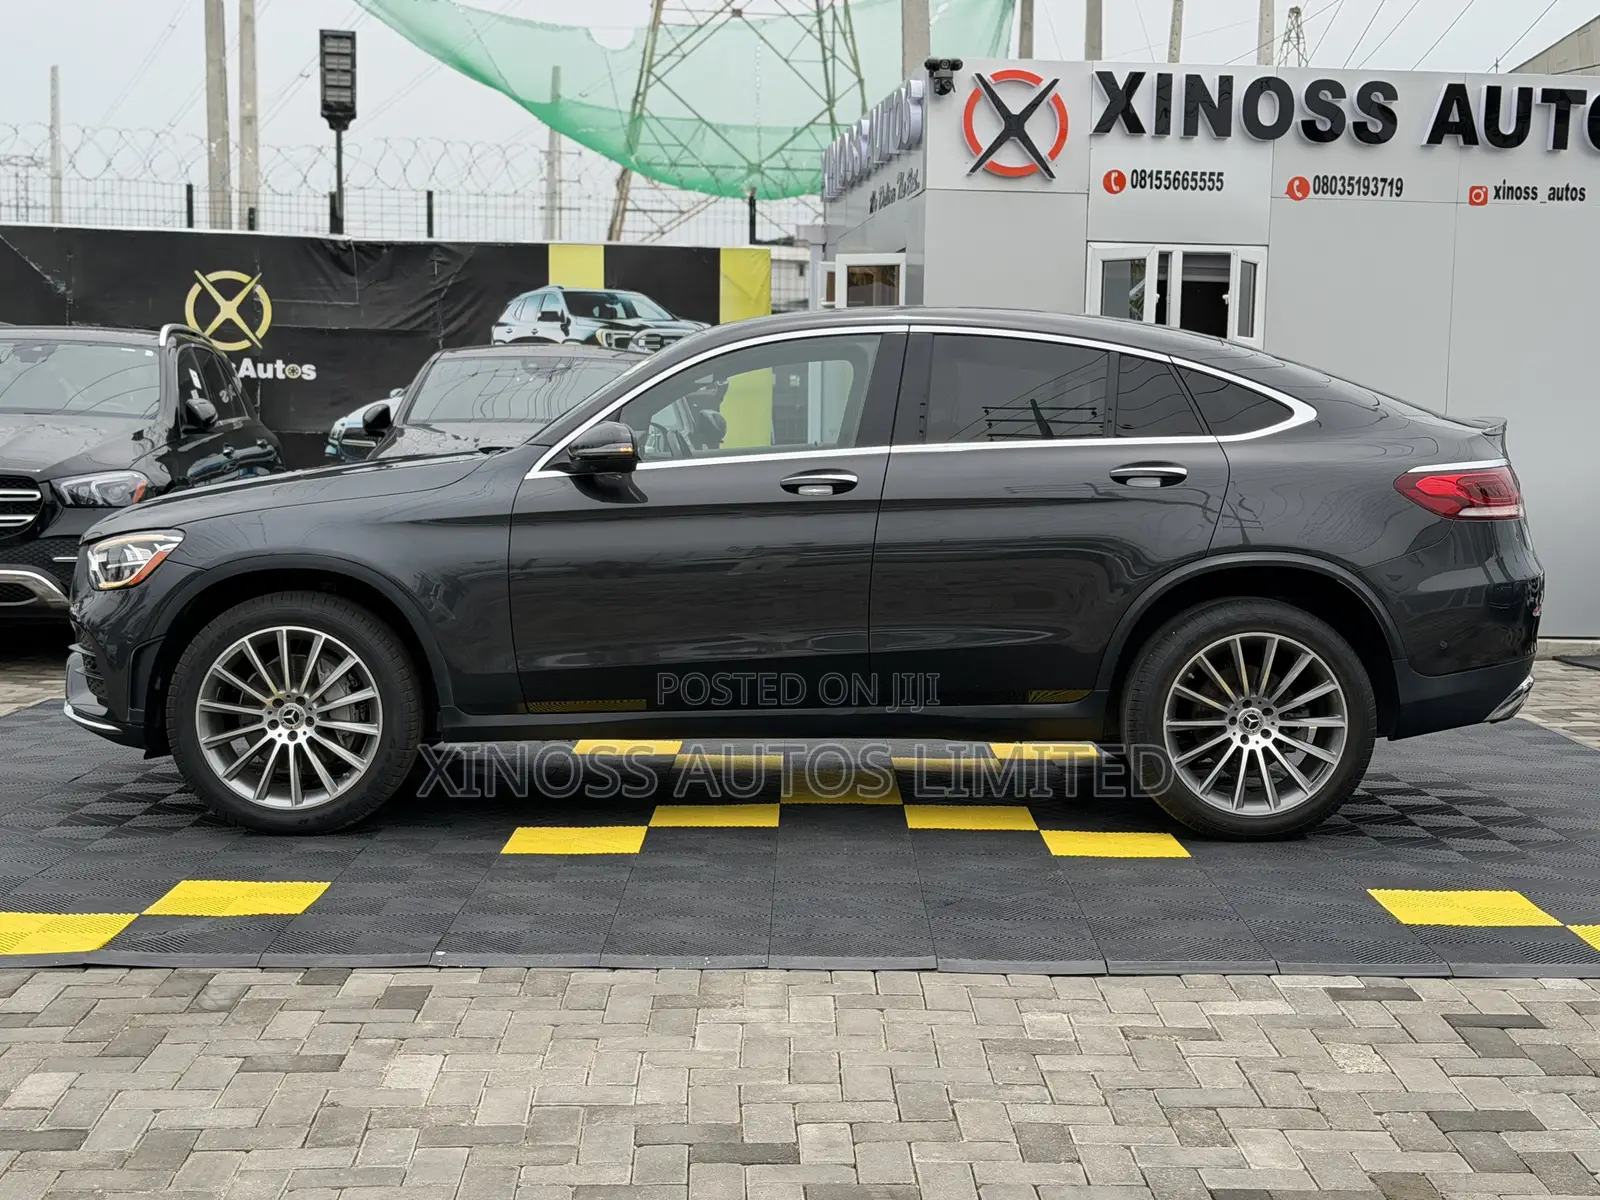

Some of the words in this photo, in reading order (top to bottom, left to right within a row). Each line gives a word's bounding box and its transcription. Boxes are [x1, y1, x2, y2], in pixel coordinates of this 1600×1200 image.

[1090, 71, 1399, 145] XINOSS
[1422, 83, 1600, 151] AUT
[1130, 169, 1224, 191] 08155665555
[1312, 174, 1404, 198] 08035193719
[231, 357, 317, 381] Autos
